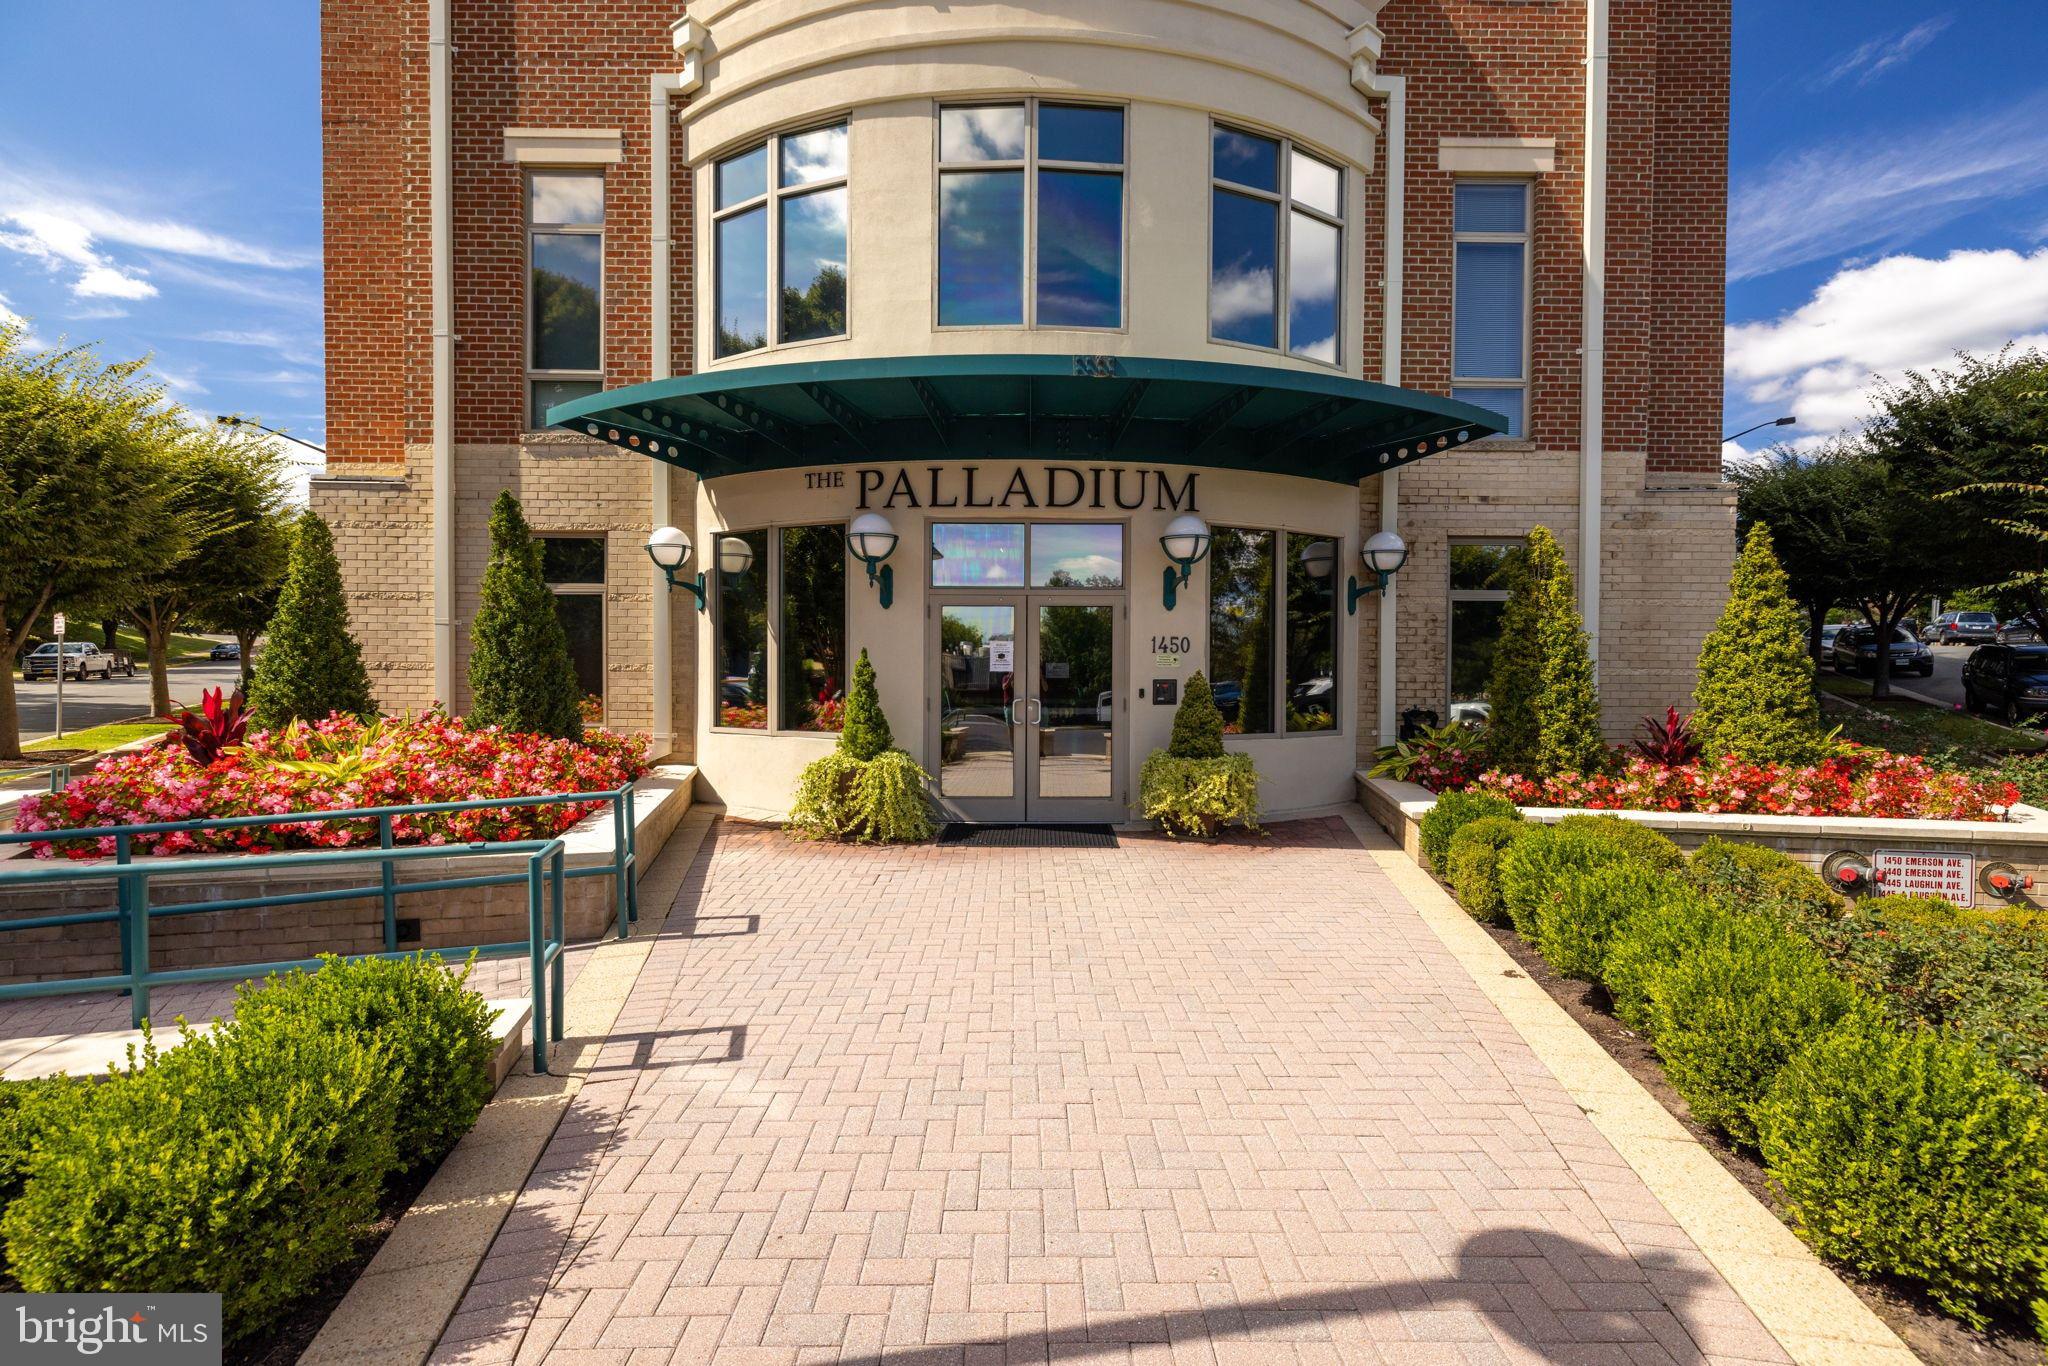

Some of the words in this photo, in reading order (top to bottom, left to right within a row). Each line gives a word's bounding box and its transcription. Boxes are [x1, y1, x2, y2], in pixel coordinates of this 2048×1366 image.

[804, 471, 844, 489] THE
[855, 466, 1200, 512] PALLADIUM
[1151, 636, 1190, 653] 1450
[1884, 856, 1902, 865] 1450
[1905, 857, 1944, 867] EMERSON
[1946, 858, 1964, 867] AVE.
[1905, 868, 1943, 878] EMERSON
[1946, 869, 1964, 879] AVE.
[1884, 879, 1901, 888] 445
[1904, 880, 1943, 889] LAUGHLIN
[1946, 881, 1964, 890] AVE.
